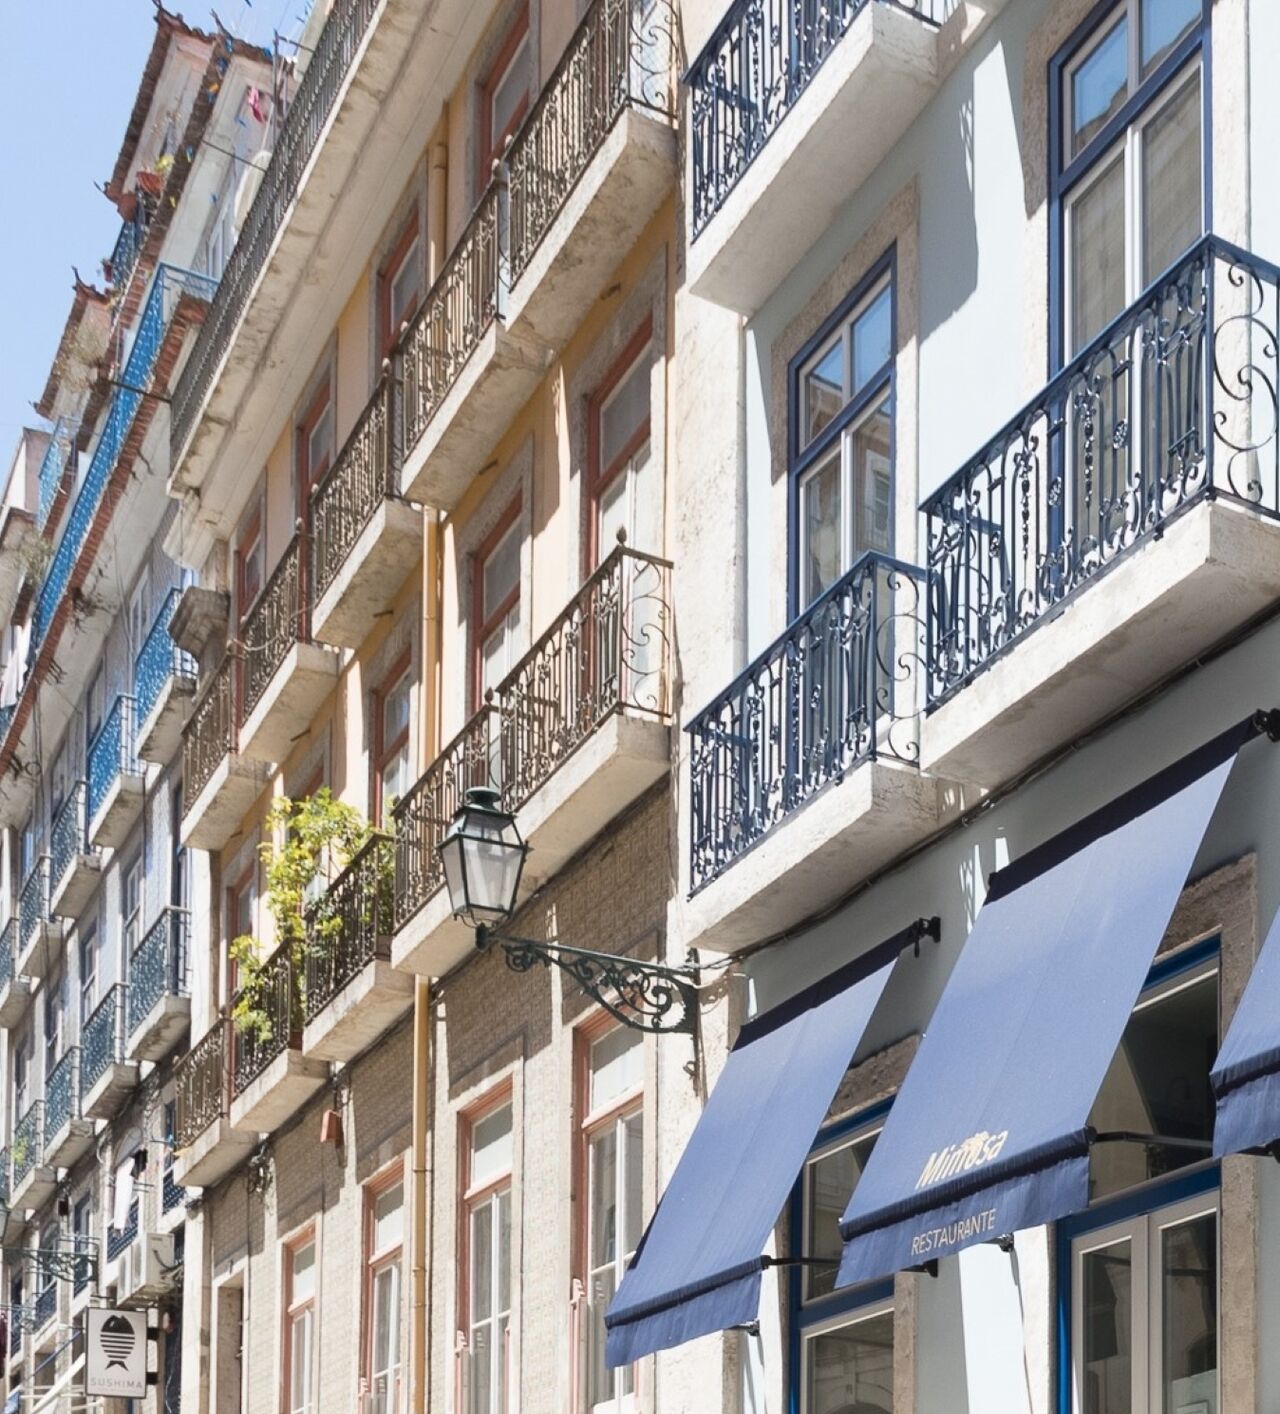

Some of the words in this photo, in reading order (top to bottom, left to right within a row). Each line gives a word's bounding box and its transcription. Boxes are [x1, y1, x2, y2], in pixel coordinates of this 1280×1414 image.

[914, 1130, 1009, 1190] Mimosa
[911, 1208, 997, 1256] RESTAURANTE
[90, 1377, 143, 1389] SUSHIMA
